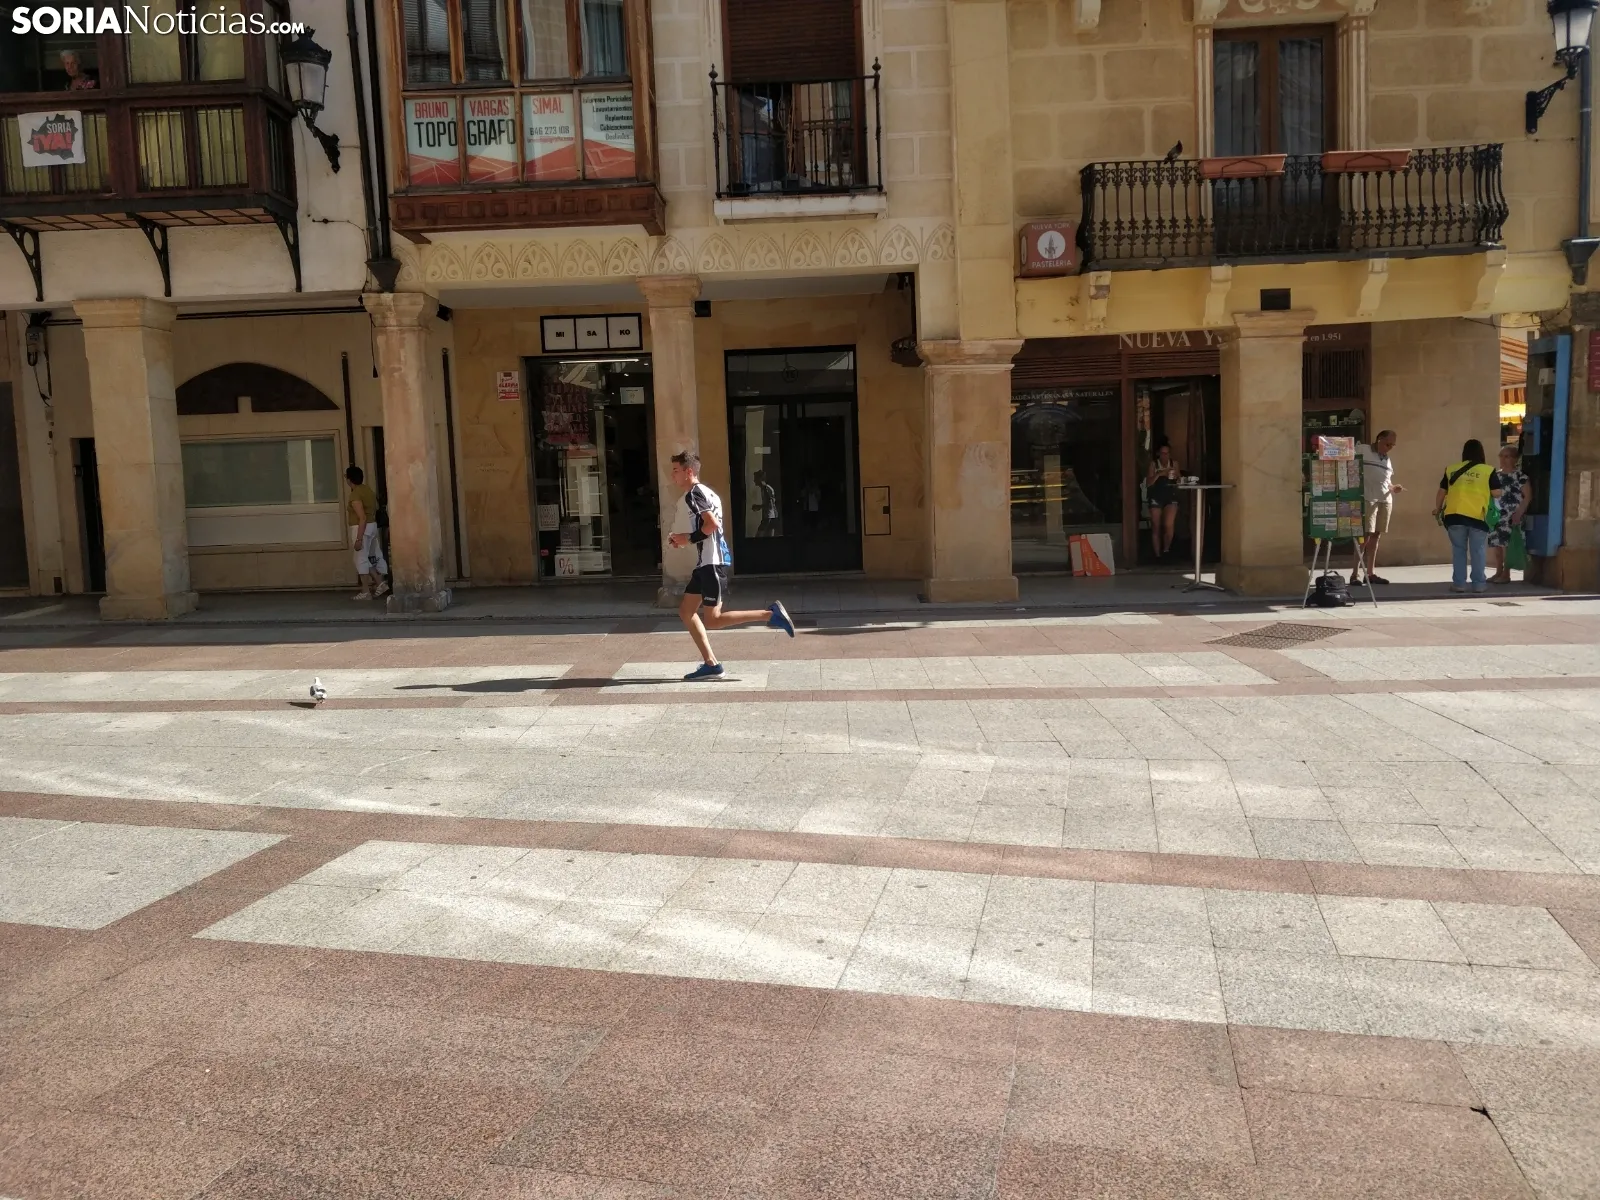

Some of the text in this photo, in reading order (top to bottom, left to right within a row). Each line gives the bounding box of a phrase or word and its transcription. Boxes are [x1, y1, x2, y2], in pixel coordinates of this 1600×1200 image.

[414, 96, 565, 119] BRUNO VARGAS SIMAL
[46, 122, 72, 134] SORIA
[544, 126, 557, 135] 273
[1118, 331, 1192, 350] NUEVA
